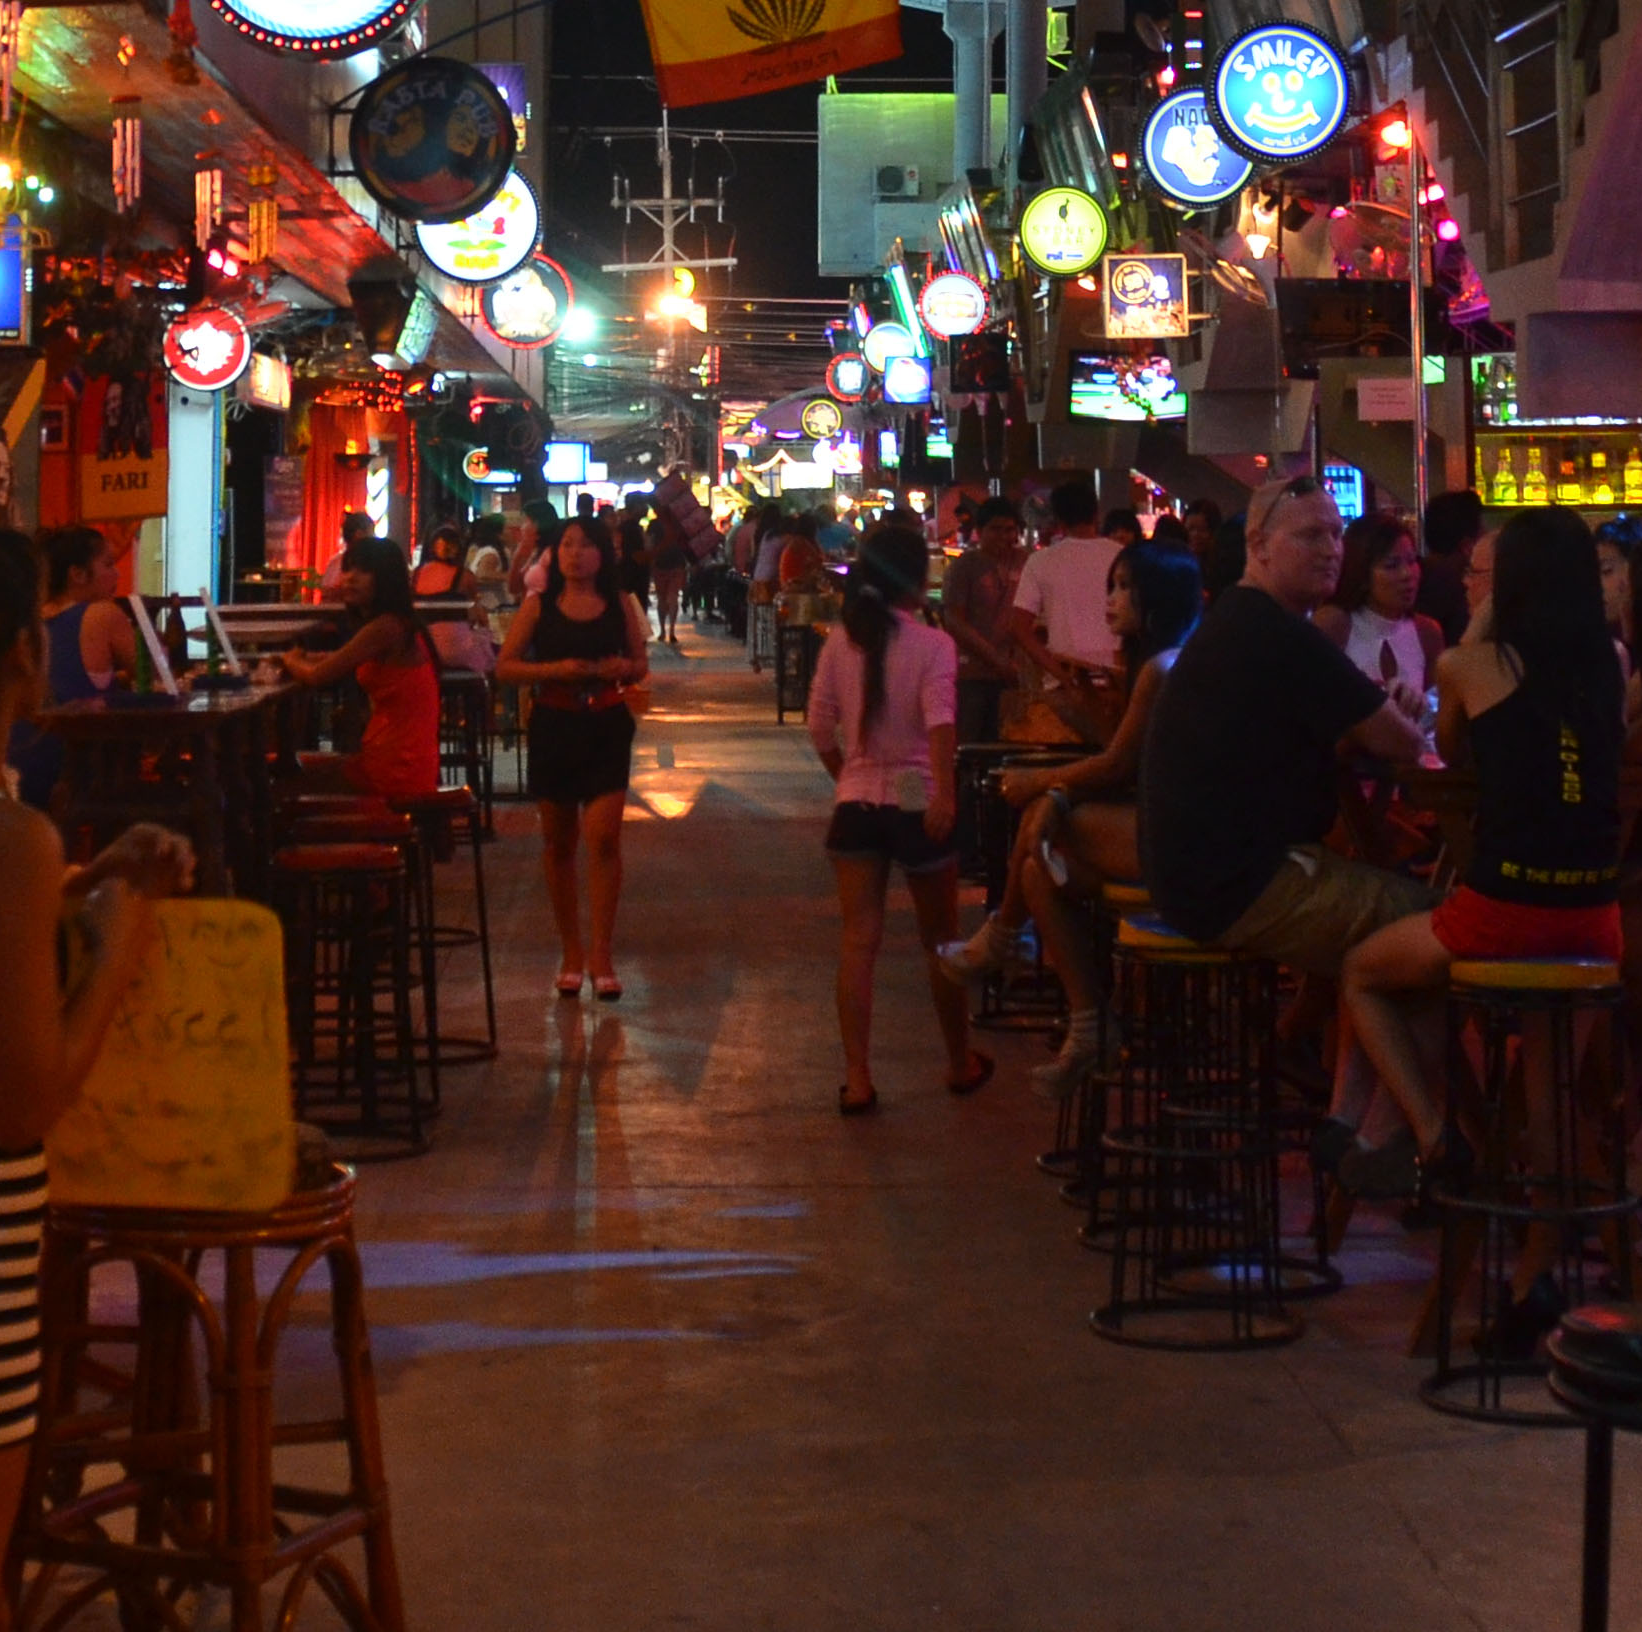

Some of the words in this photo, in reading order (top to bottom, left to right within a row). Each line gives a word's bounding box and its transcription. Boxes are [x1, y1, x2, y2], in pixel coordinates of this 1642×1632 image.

[1232, 39, 1331, 82] SMILEY
[367, 79, 447, 136] RASTA
[100, 471, 149, 493] FARI
